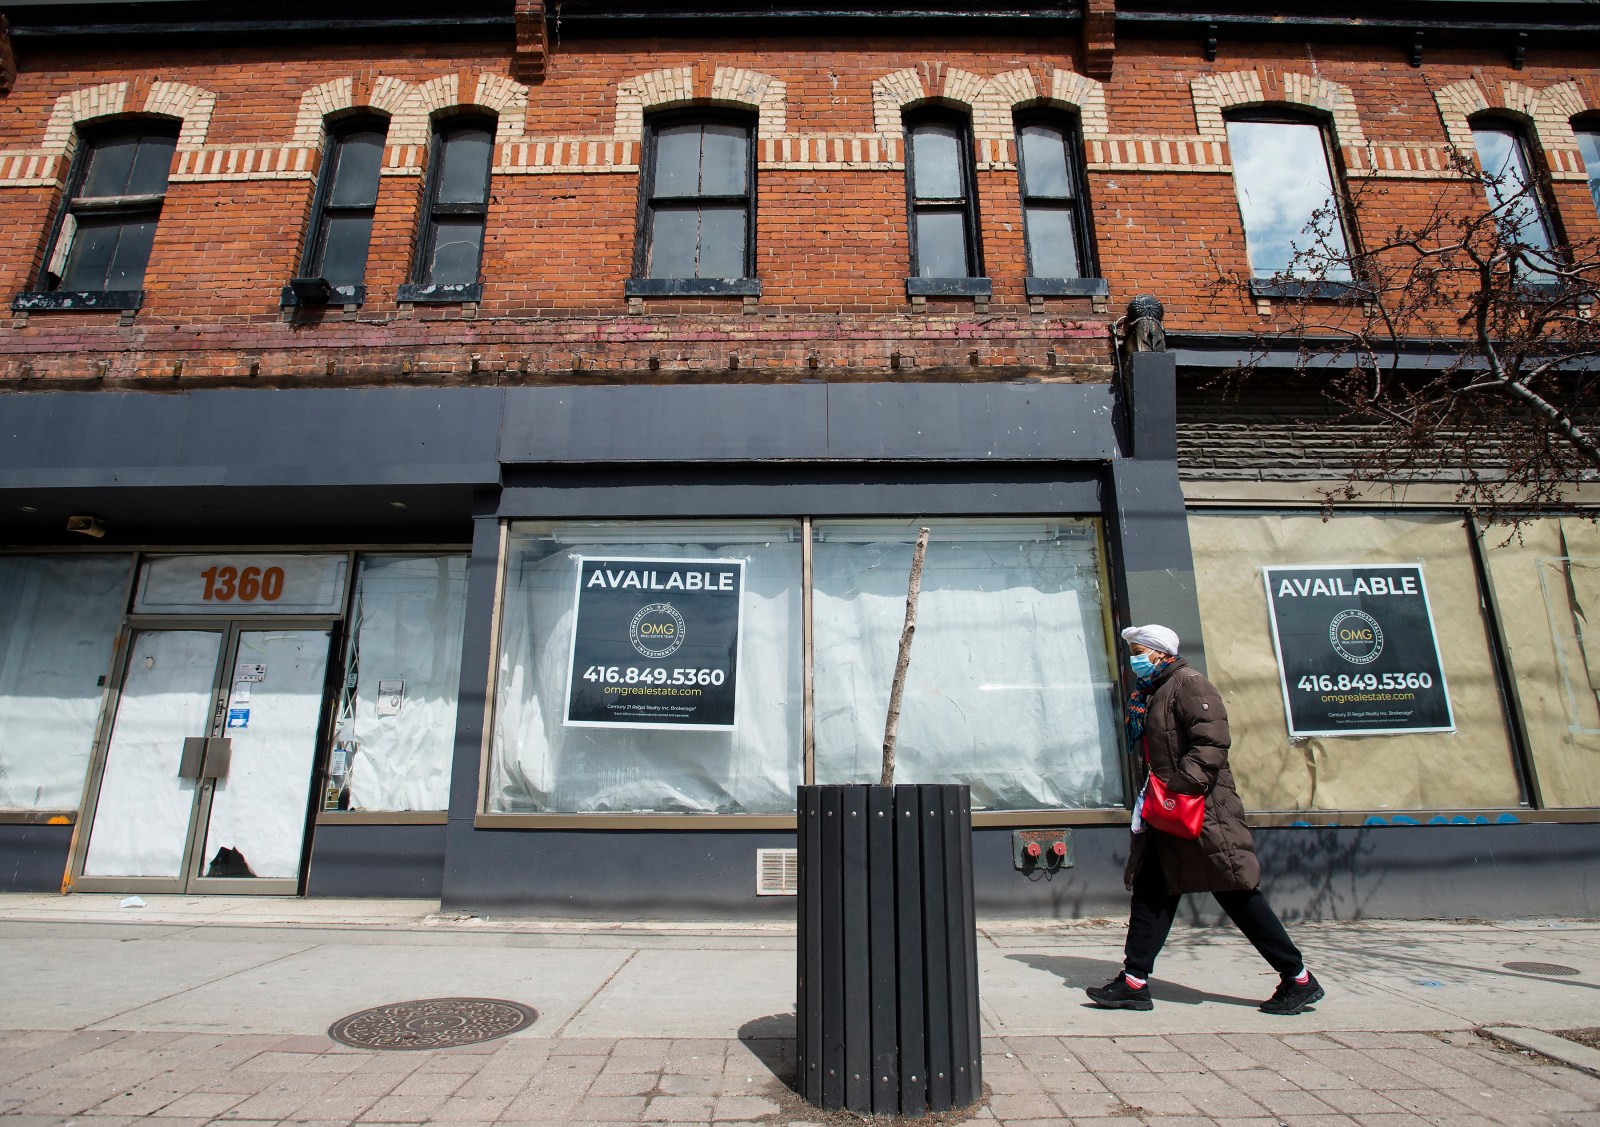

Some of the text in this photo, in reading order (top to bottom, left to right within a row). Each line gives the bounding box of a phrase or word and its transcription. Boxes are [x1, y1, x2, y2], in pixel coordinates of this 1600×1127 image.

[201, 566, 284, 601] 1360
[587, 570, 734, 591] AVAILABLE
[1278, 576, 1418, 597] AVAILABLE
[631, 605, 654, 637] COMMERCIAL
[641, 623, 674, 634] OMG
[1331, 612, 1347, 644] COMMERCIAL
[1340, 629, 1372, 640] OMG
[637, 645, 676, 657] INVESTMENTS
[1341, 651, 1379, 663] INVESTMENTS
[583, 666, 725, 686] 416.849.5360
[1297, 672, 1433, 692] 416.849.5360
[604, 686, 702, 697] omgrealestate.com
[1321, 692, 1415, 704] omgrealestate.com
